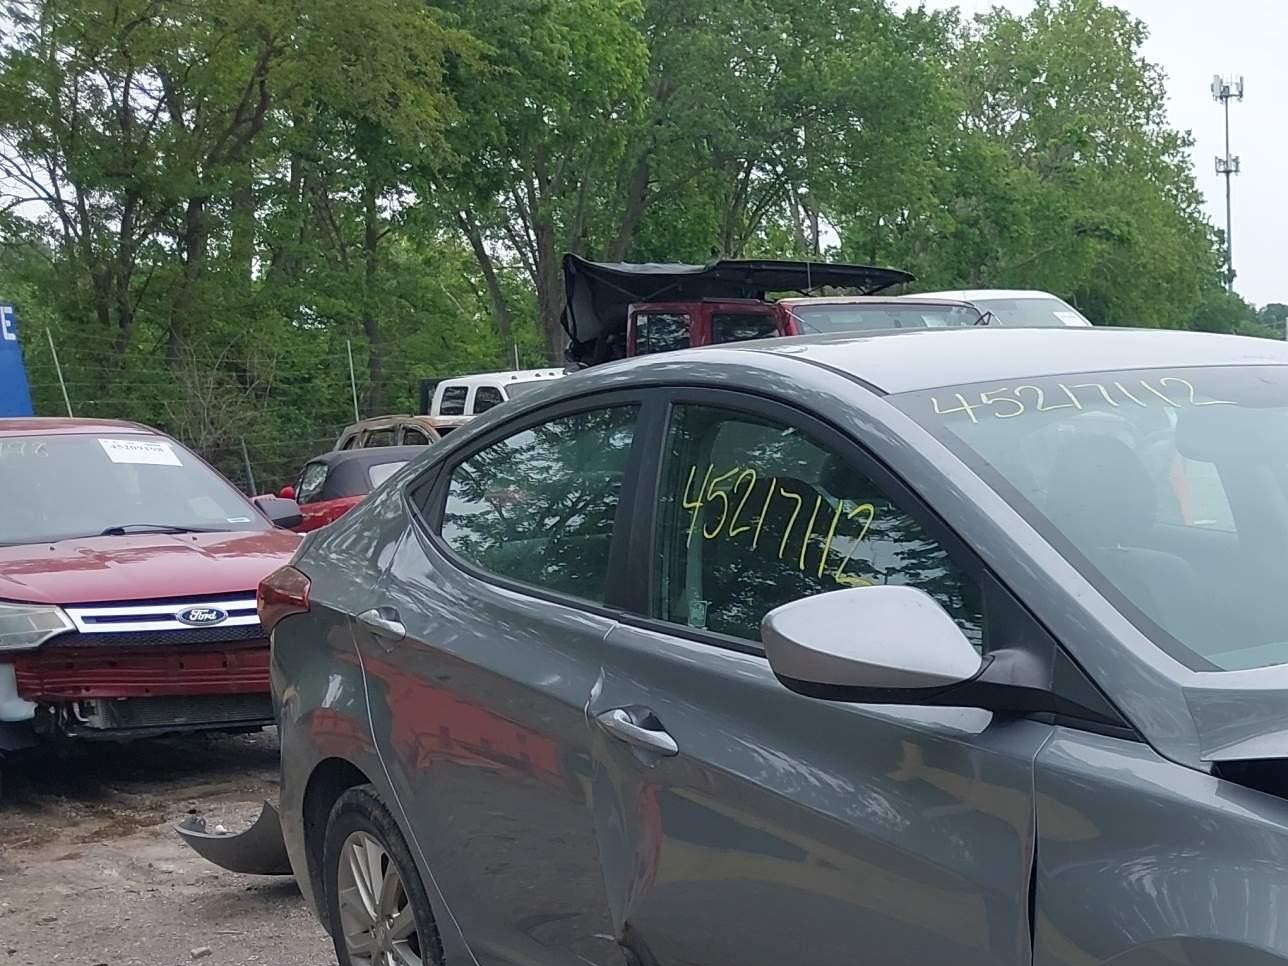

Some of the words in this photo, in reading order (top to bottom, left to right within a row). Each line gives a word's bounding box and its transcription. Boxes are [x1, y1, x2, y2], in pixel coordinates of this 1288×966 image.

[0, 306, 16, 340] E
[929, 377, 1238, 423] 45217112
[682, 463, 875, 587] 45217112
[190, 609, 217, 620] Ford
